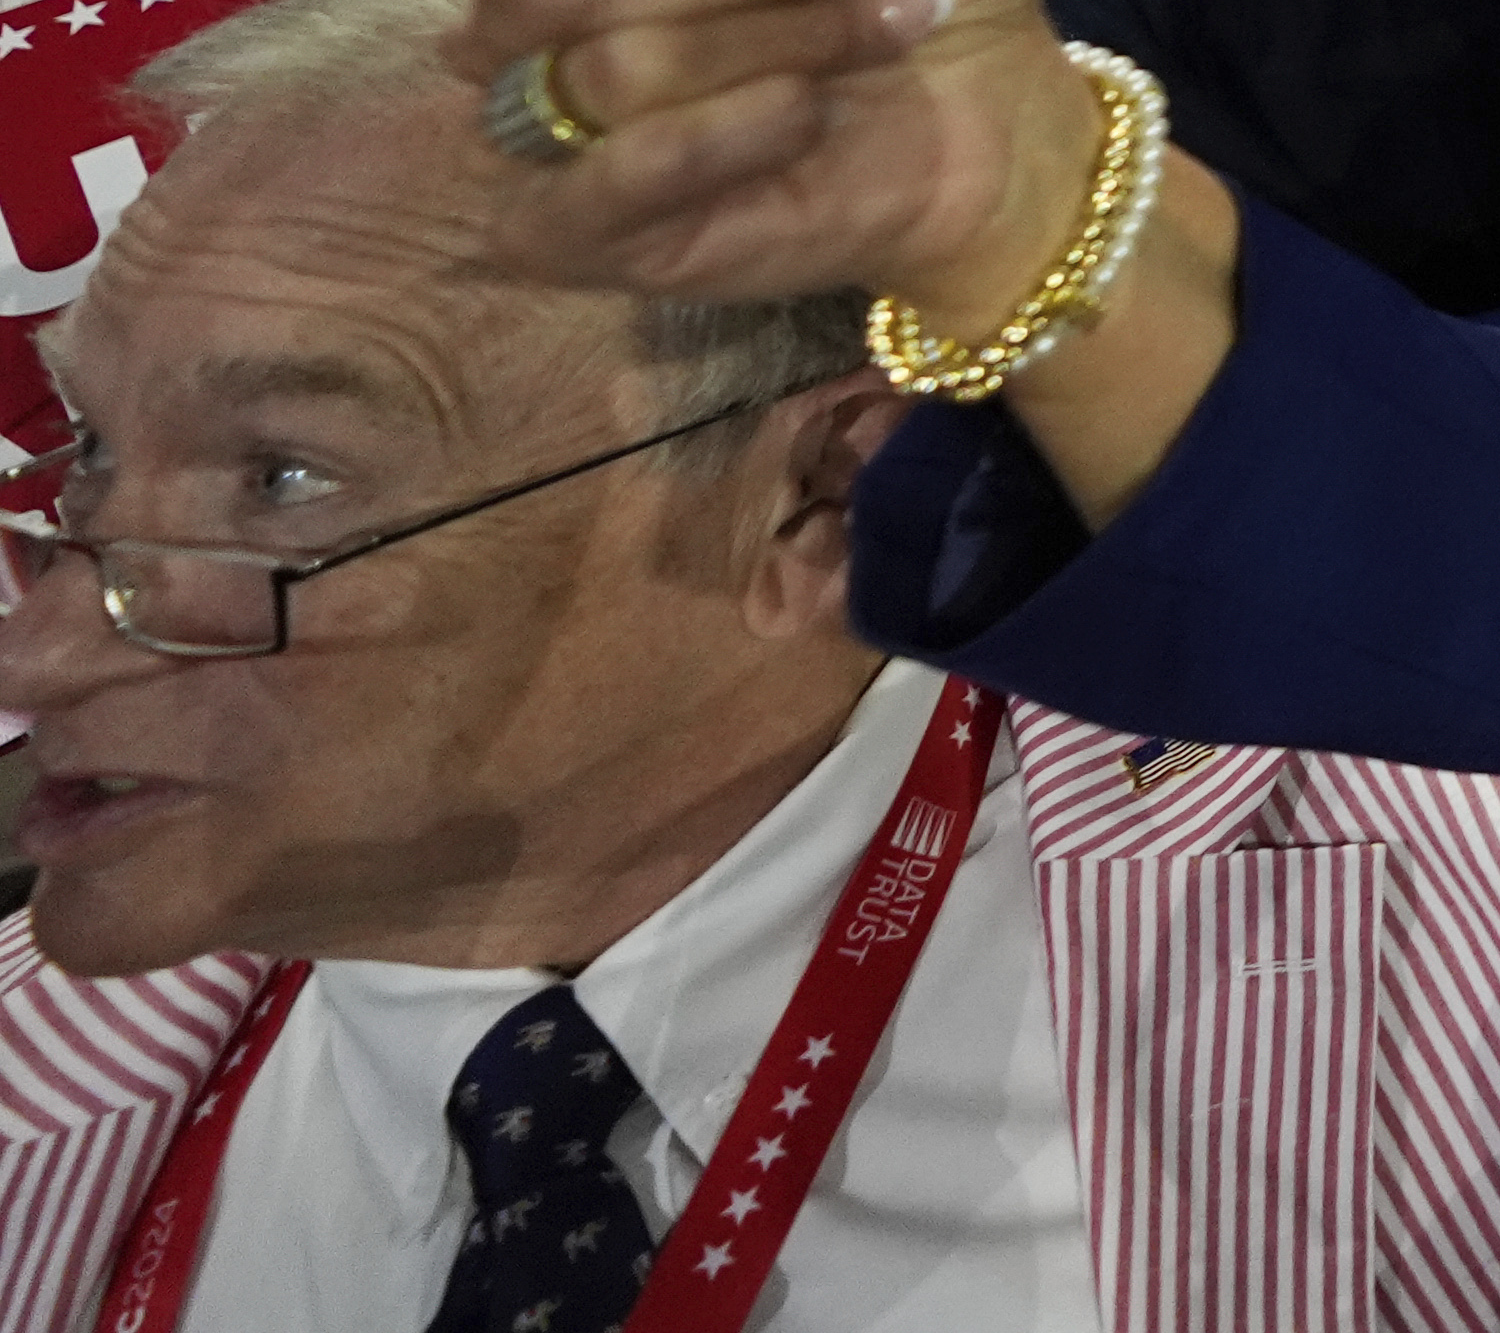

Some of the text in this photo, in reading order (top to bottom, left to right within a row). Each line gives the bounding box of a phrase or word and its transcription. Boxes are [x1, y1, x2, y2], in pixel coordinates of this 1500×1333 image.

[837, 857, 909, 966] TRUST
[877, 859, 937, 943] DATA
[115, 1199, 180, 1333] C2024
